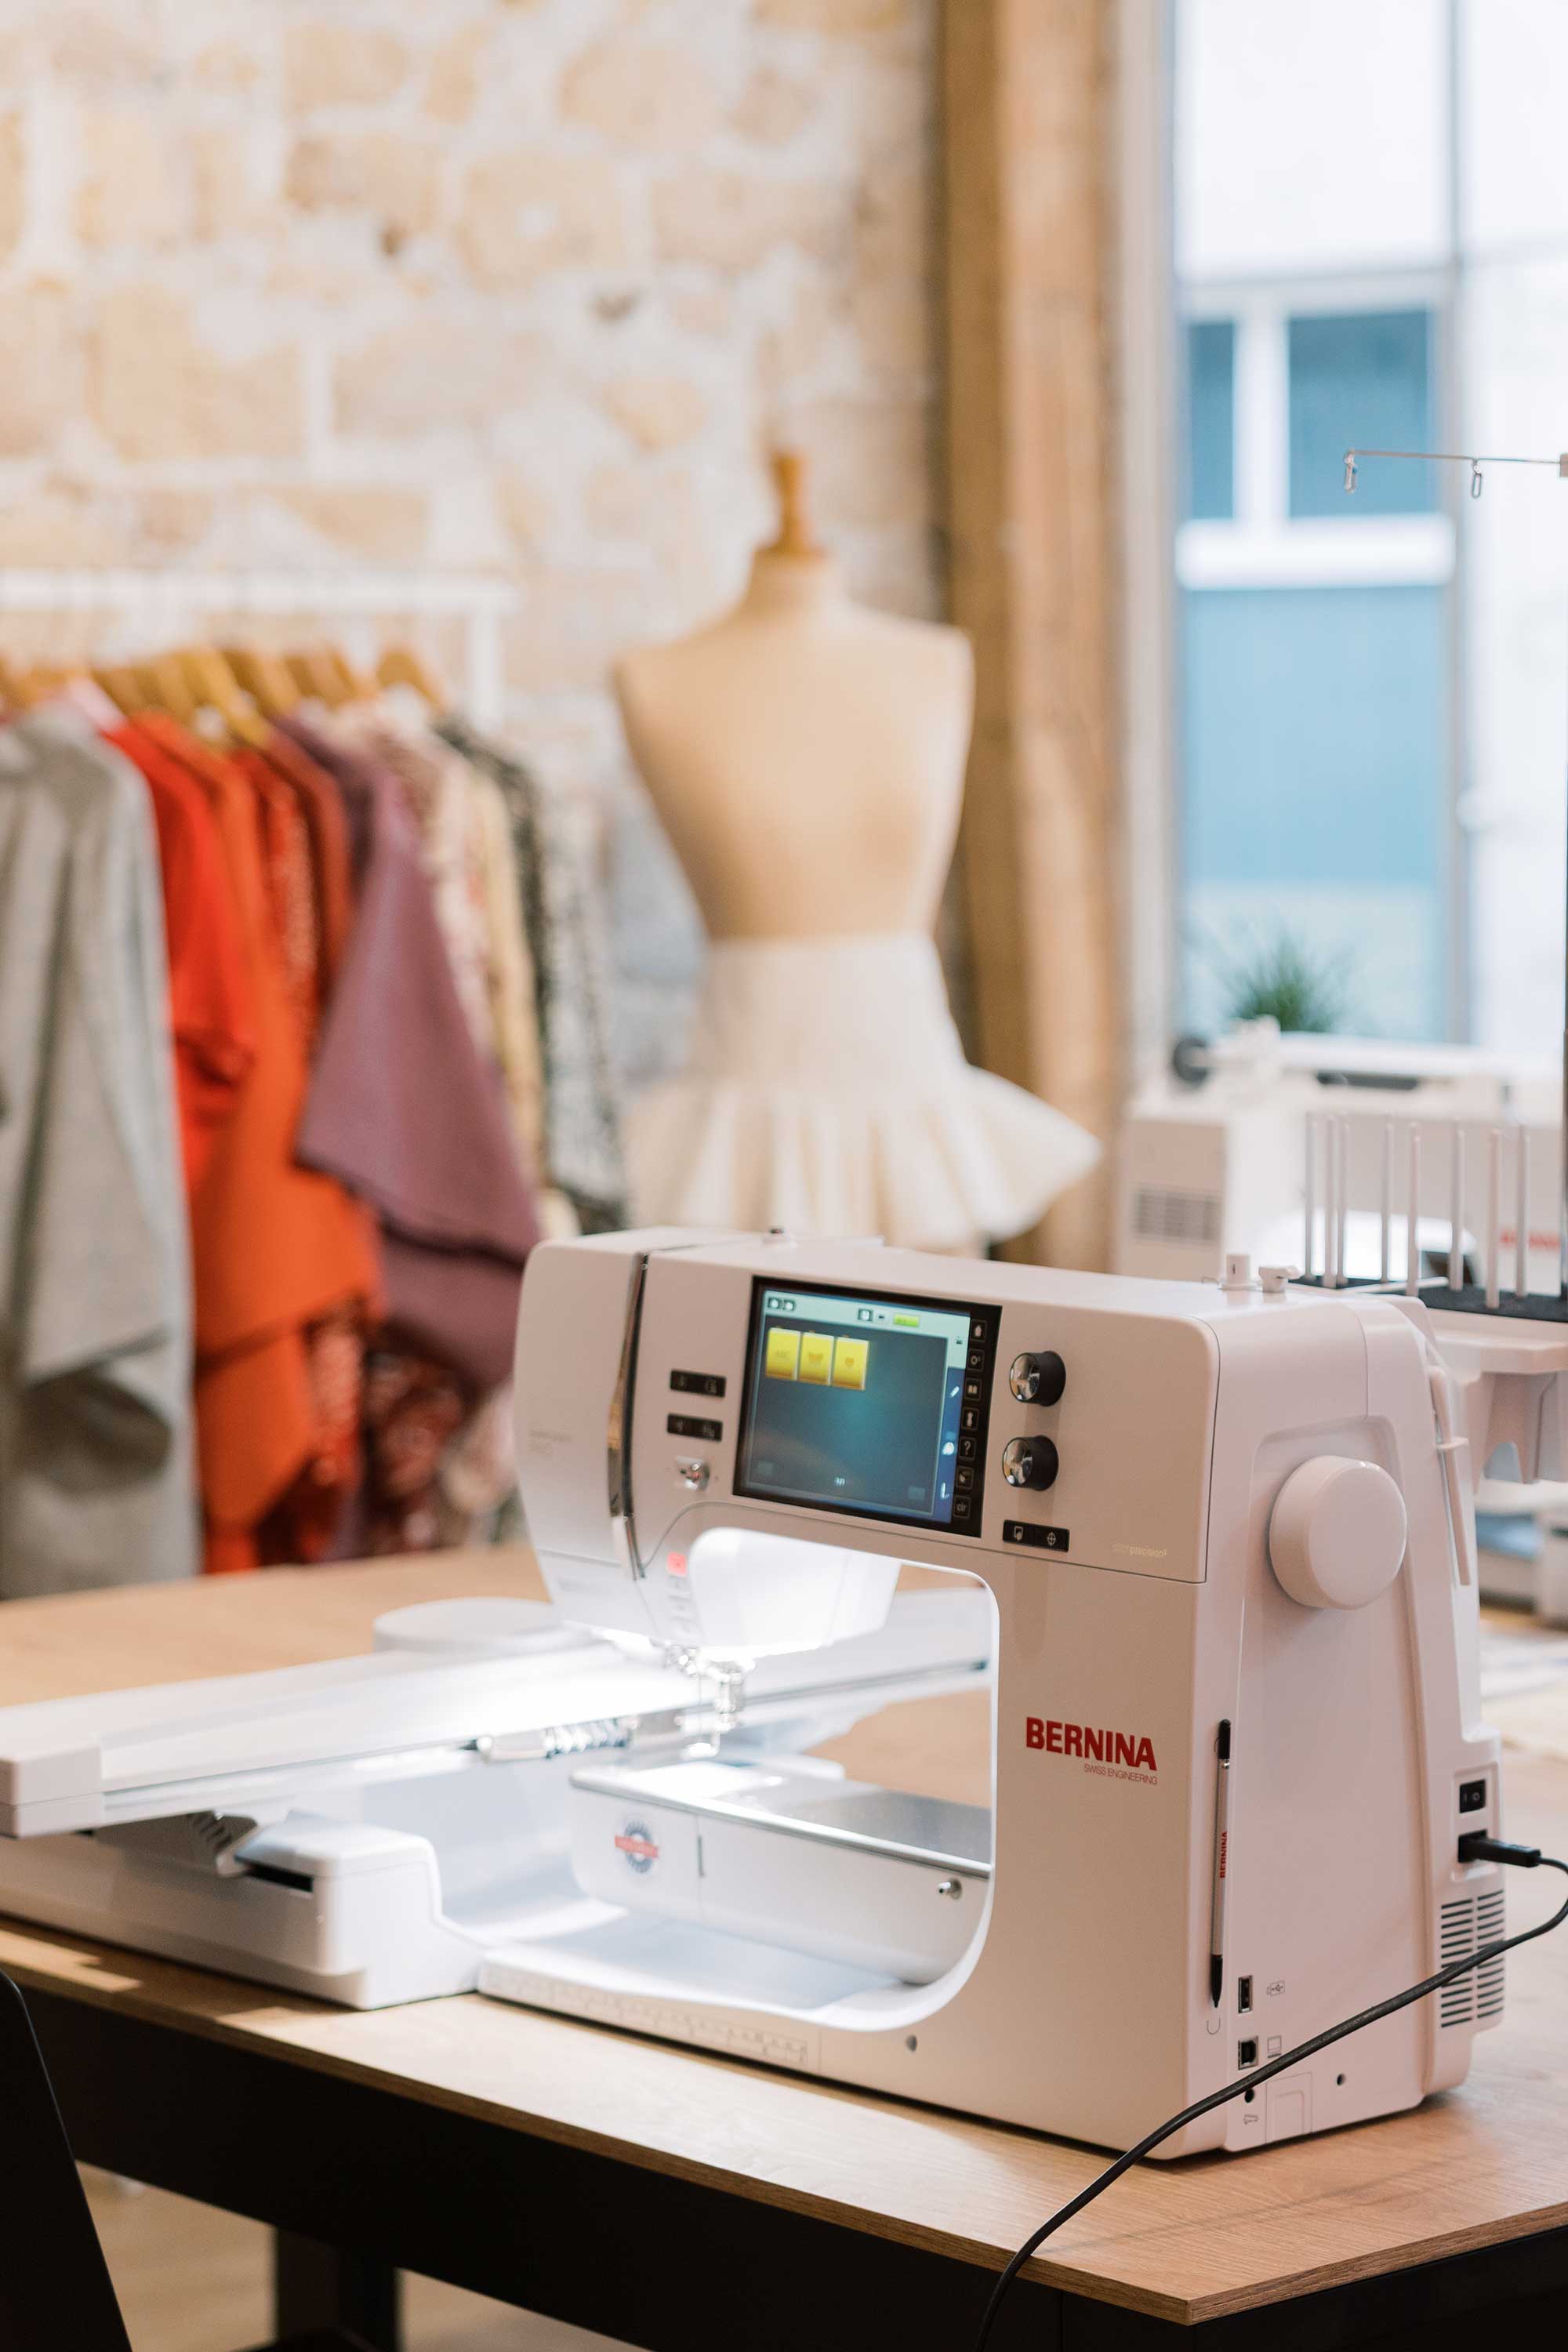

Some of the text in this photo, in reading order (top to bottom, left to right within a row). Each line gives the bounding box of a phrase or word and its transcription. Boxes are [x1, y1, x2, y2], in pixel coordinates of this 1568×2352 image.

[1026, 1716, 1157, 1771] BERNINA
[1083, 1763, 1158, 1785] SWISS ENGINEERING
[1219, 1831, 1228, 1878] BERNINA
